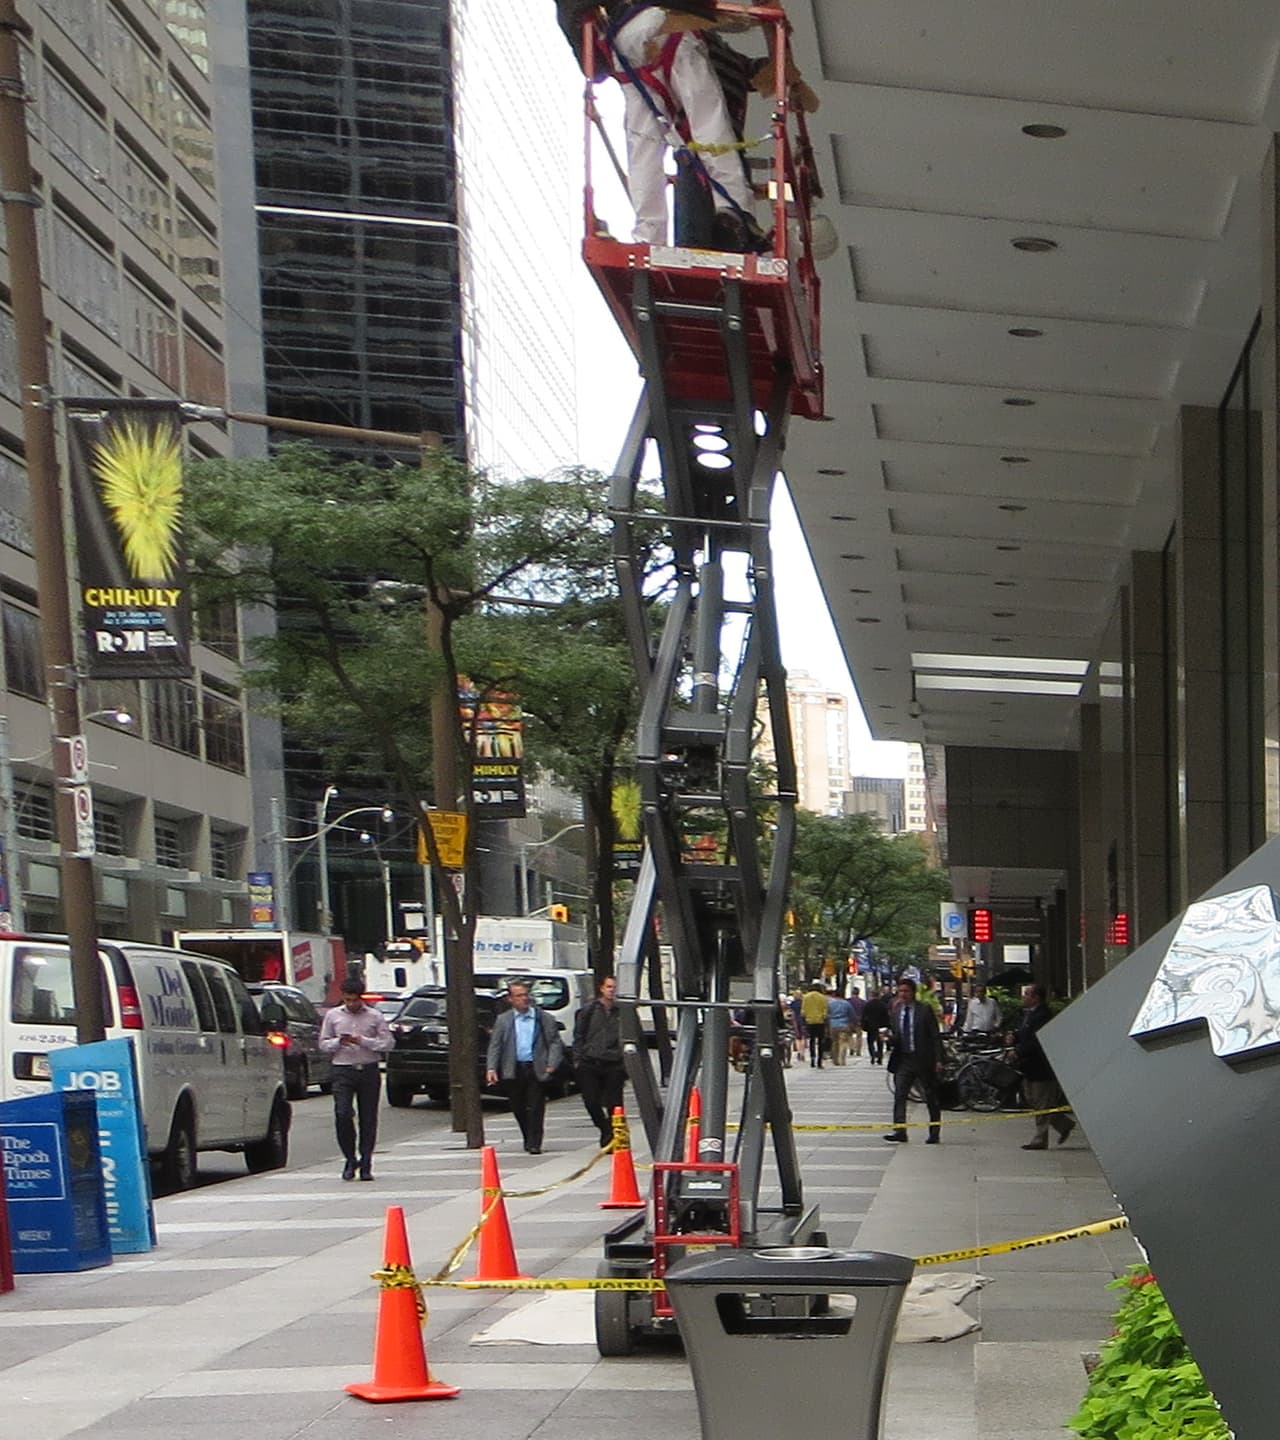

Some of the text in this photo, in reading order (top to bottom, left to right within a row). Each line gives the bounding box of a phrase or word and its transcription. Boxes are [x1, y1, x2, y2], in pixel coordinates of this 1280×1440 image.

[84, 587, 182, 608] CHIHULY
[472, 764, 520, 776] HIHULY
[476, 940, 534, 952] hred-it
[62, 1070, 122, 1091] JOB
[0, 1135, 31, 1150] The
[3, 1149, 50, 1168] Epoch
[4, 1167, 52, 1180] Times
